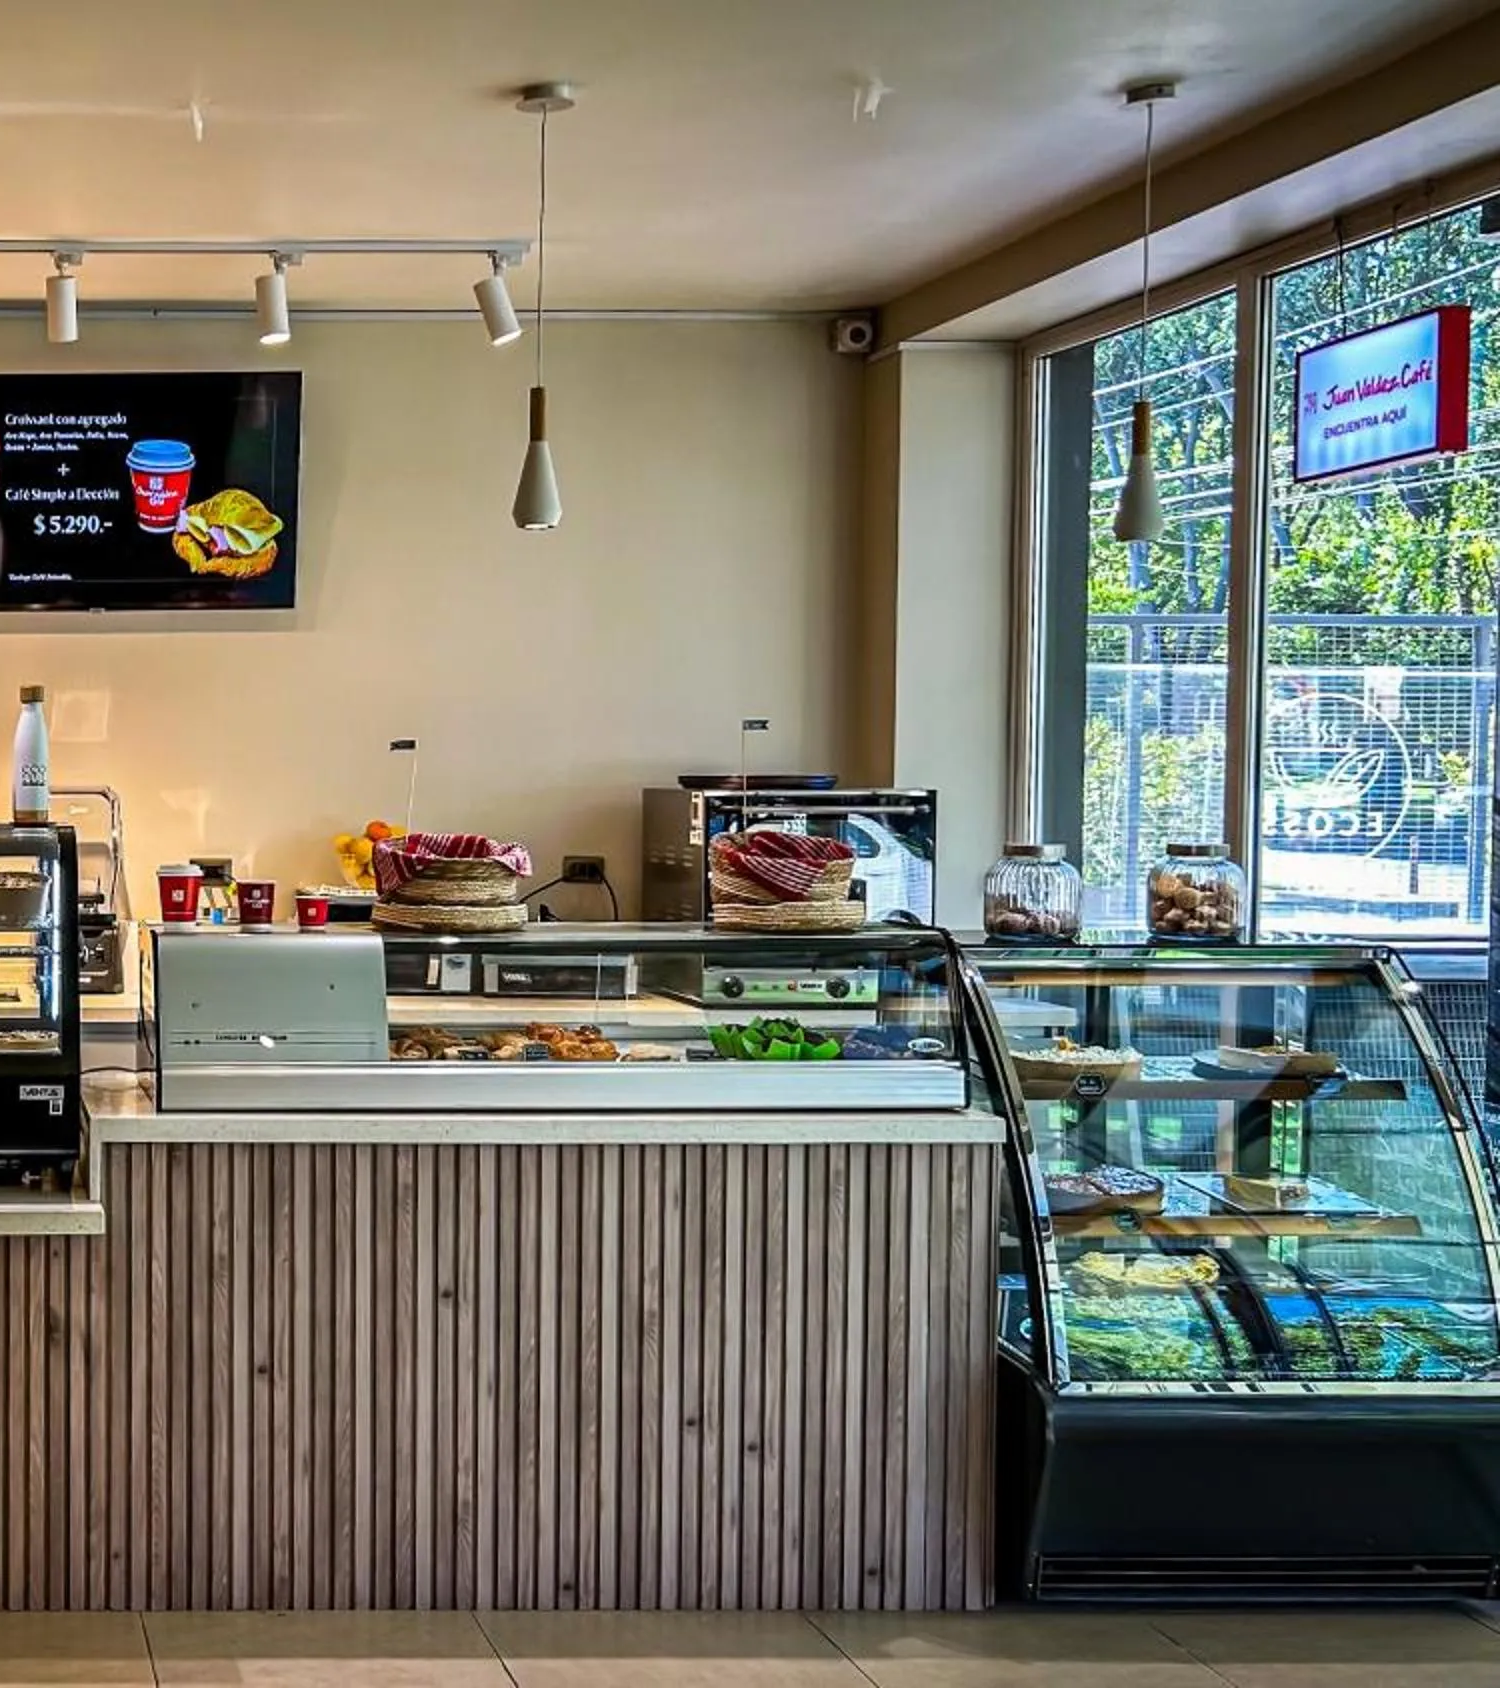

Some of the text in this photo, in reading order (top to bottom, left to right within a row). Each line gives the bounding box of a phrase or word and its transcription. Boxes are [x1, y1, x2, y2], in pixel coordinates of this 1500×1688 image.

[1323, 359, 1433, 411] Juan Valdez Café
[56, 415, 77, 425] con
[77, 412, 127, 429] agregado
[1323, 415, 1379, 439] ENCUENTRA
[5, 488, 30, 501] Café
[31, 488, 66, 503] Simple
[33, 513, 113, 536] $ 5.290.-
